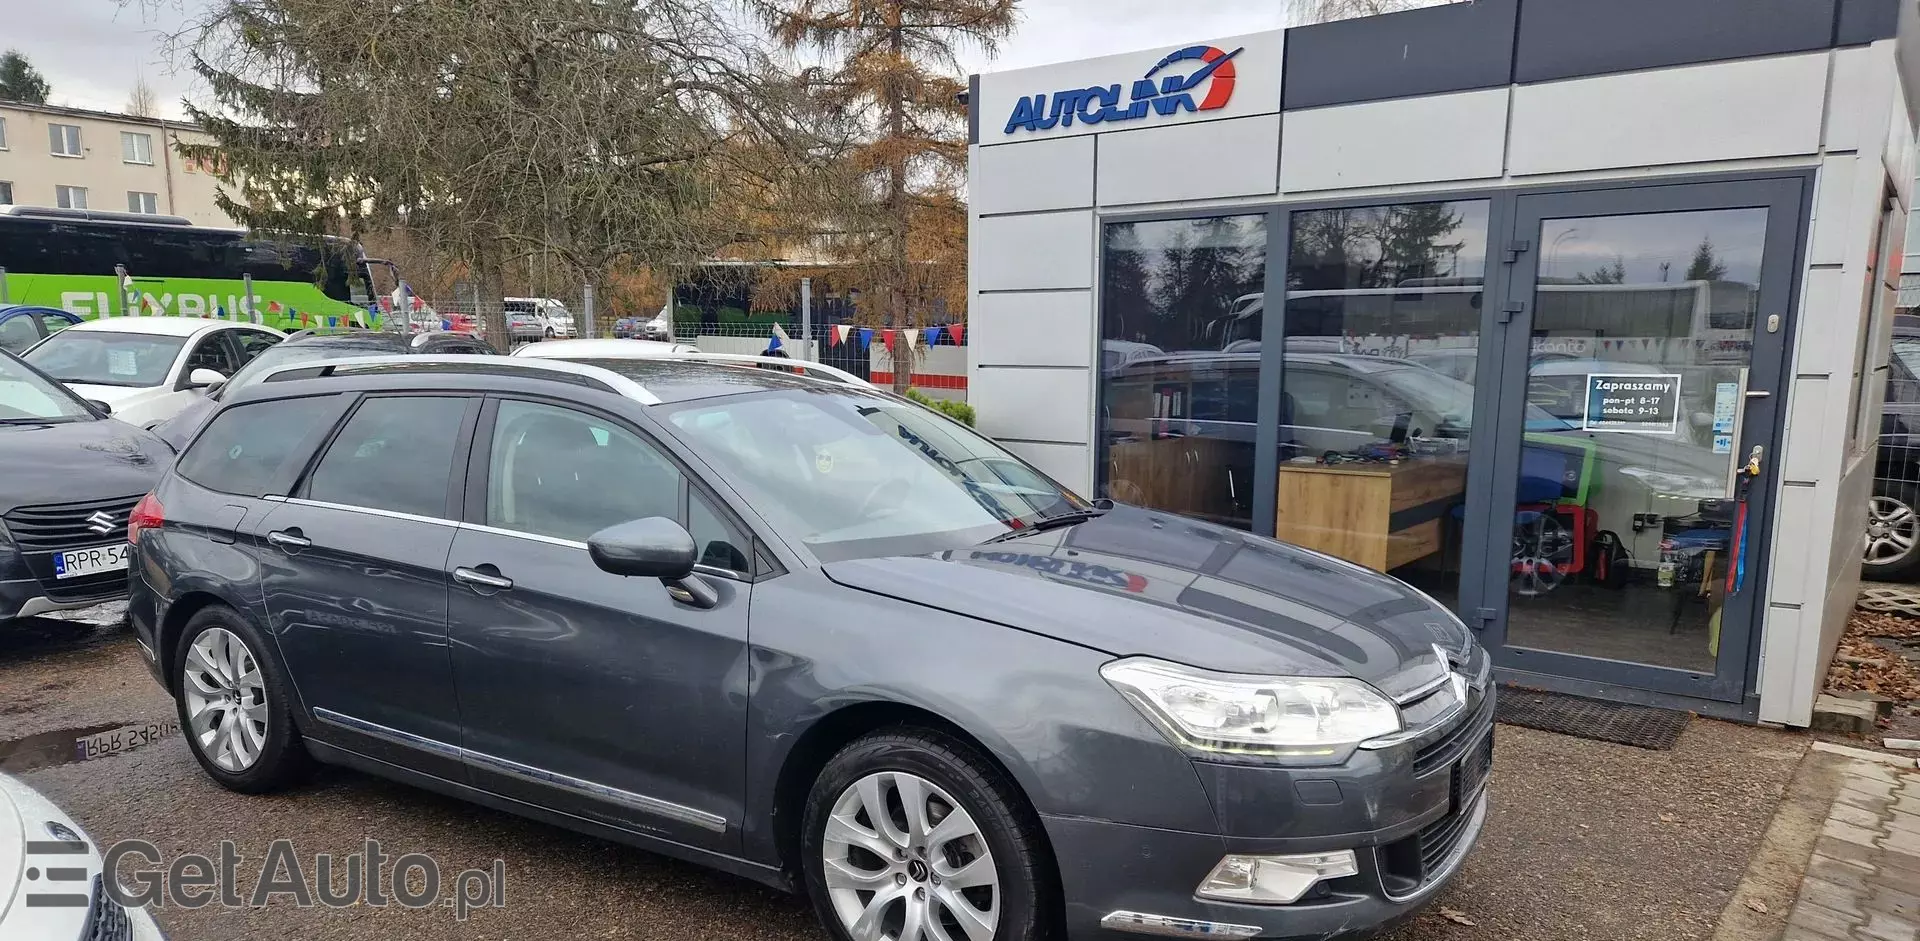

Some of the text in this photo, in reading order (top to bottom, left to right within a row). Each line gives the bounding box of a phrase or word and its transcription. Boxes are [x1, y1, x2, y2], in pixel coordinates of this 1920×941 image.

[1004, 72, 1203, 134] AUTOLINK
[1595, 379, 1671, 394] Zapraszamy
[1602, 396, 1661, 406] pon-pt 8-17
[1638, 407, 1659, 415] 9-13
[63, 549, 102, 572] RPR
